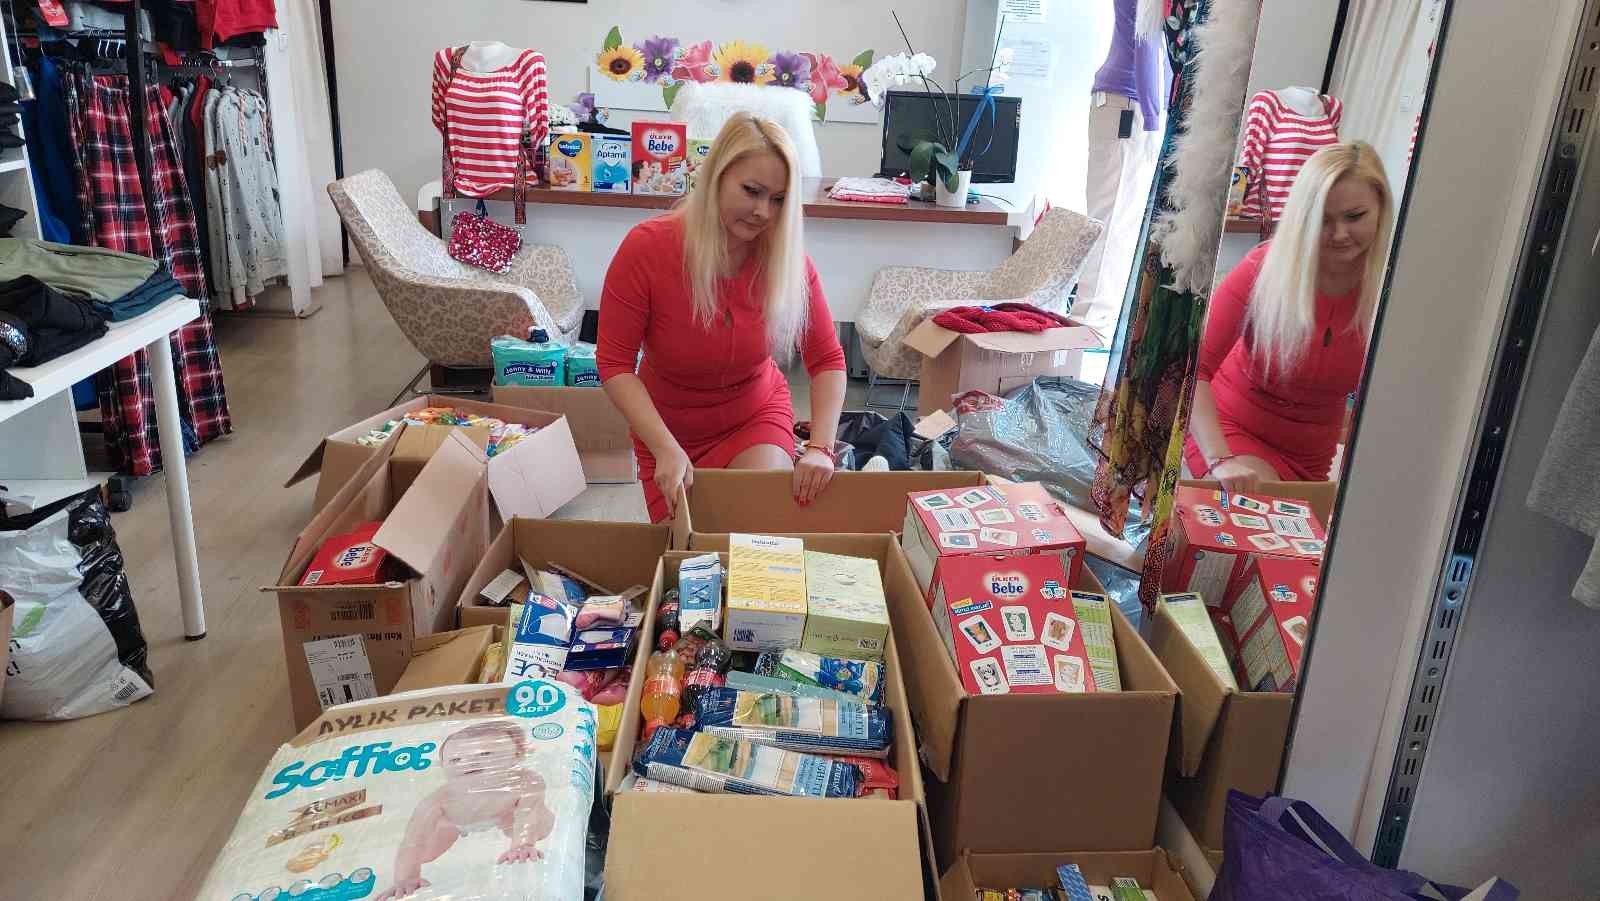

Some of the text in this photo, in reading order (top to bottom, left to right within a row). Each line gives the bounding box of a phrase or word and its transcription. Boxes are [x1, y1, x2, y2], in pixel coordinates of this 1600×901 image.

[648, 139, 674, 152] Bebe
[597, 150, 627, 160] Aptamil
[991, 581, 1024, 594] Bebe
[515, 685, 559, 706] 90
[516, 704, 550, 713] ADET
[319, 697, 500, 736] AYLIK PAKET
